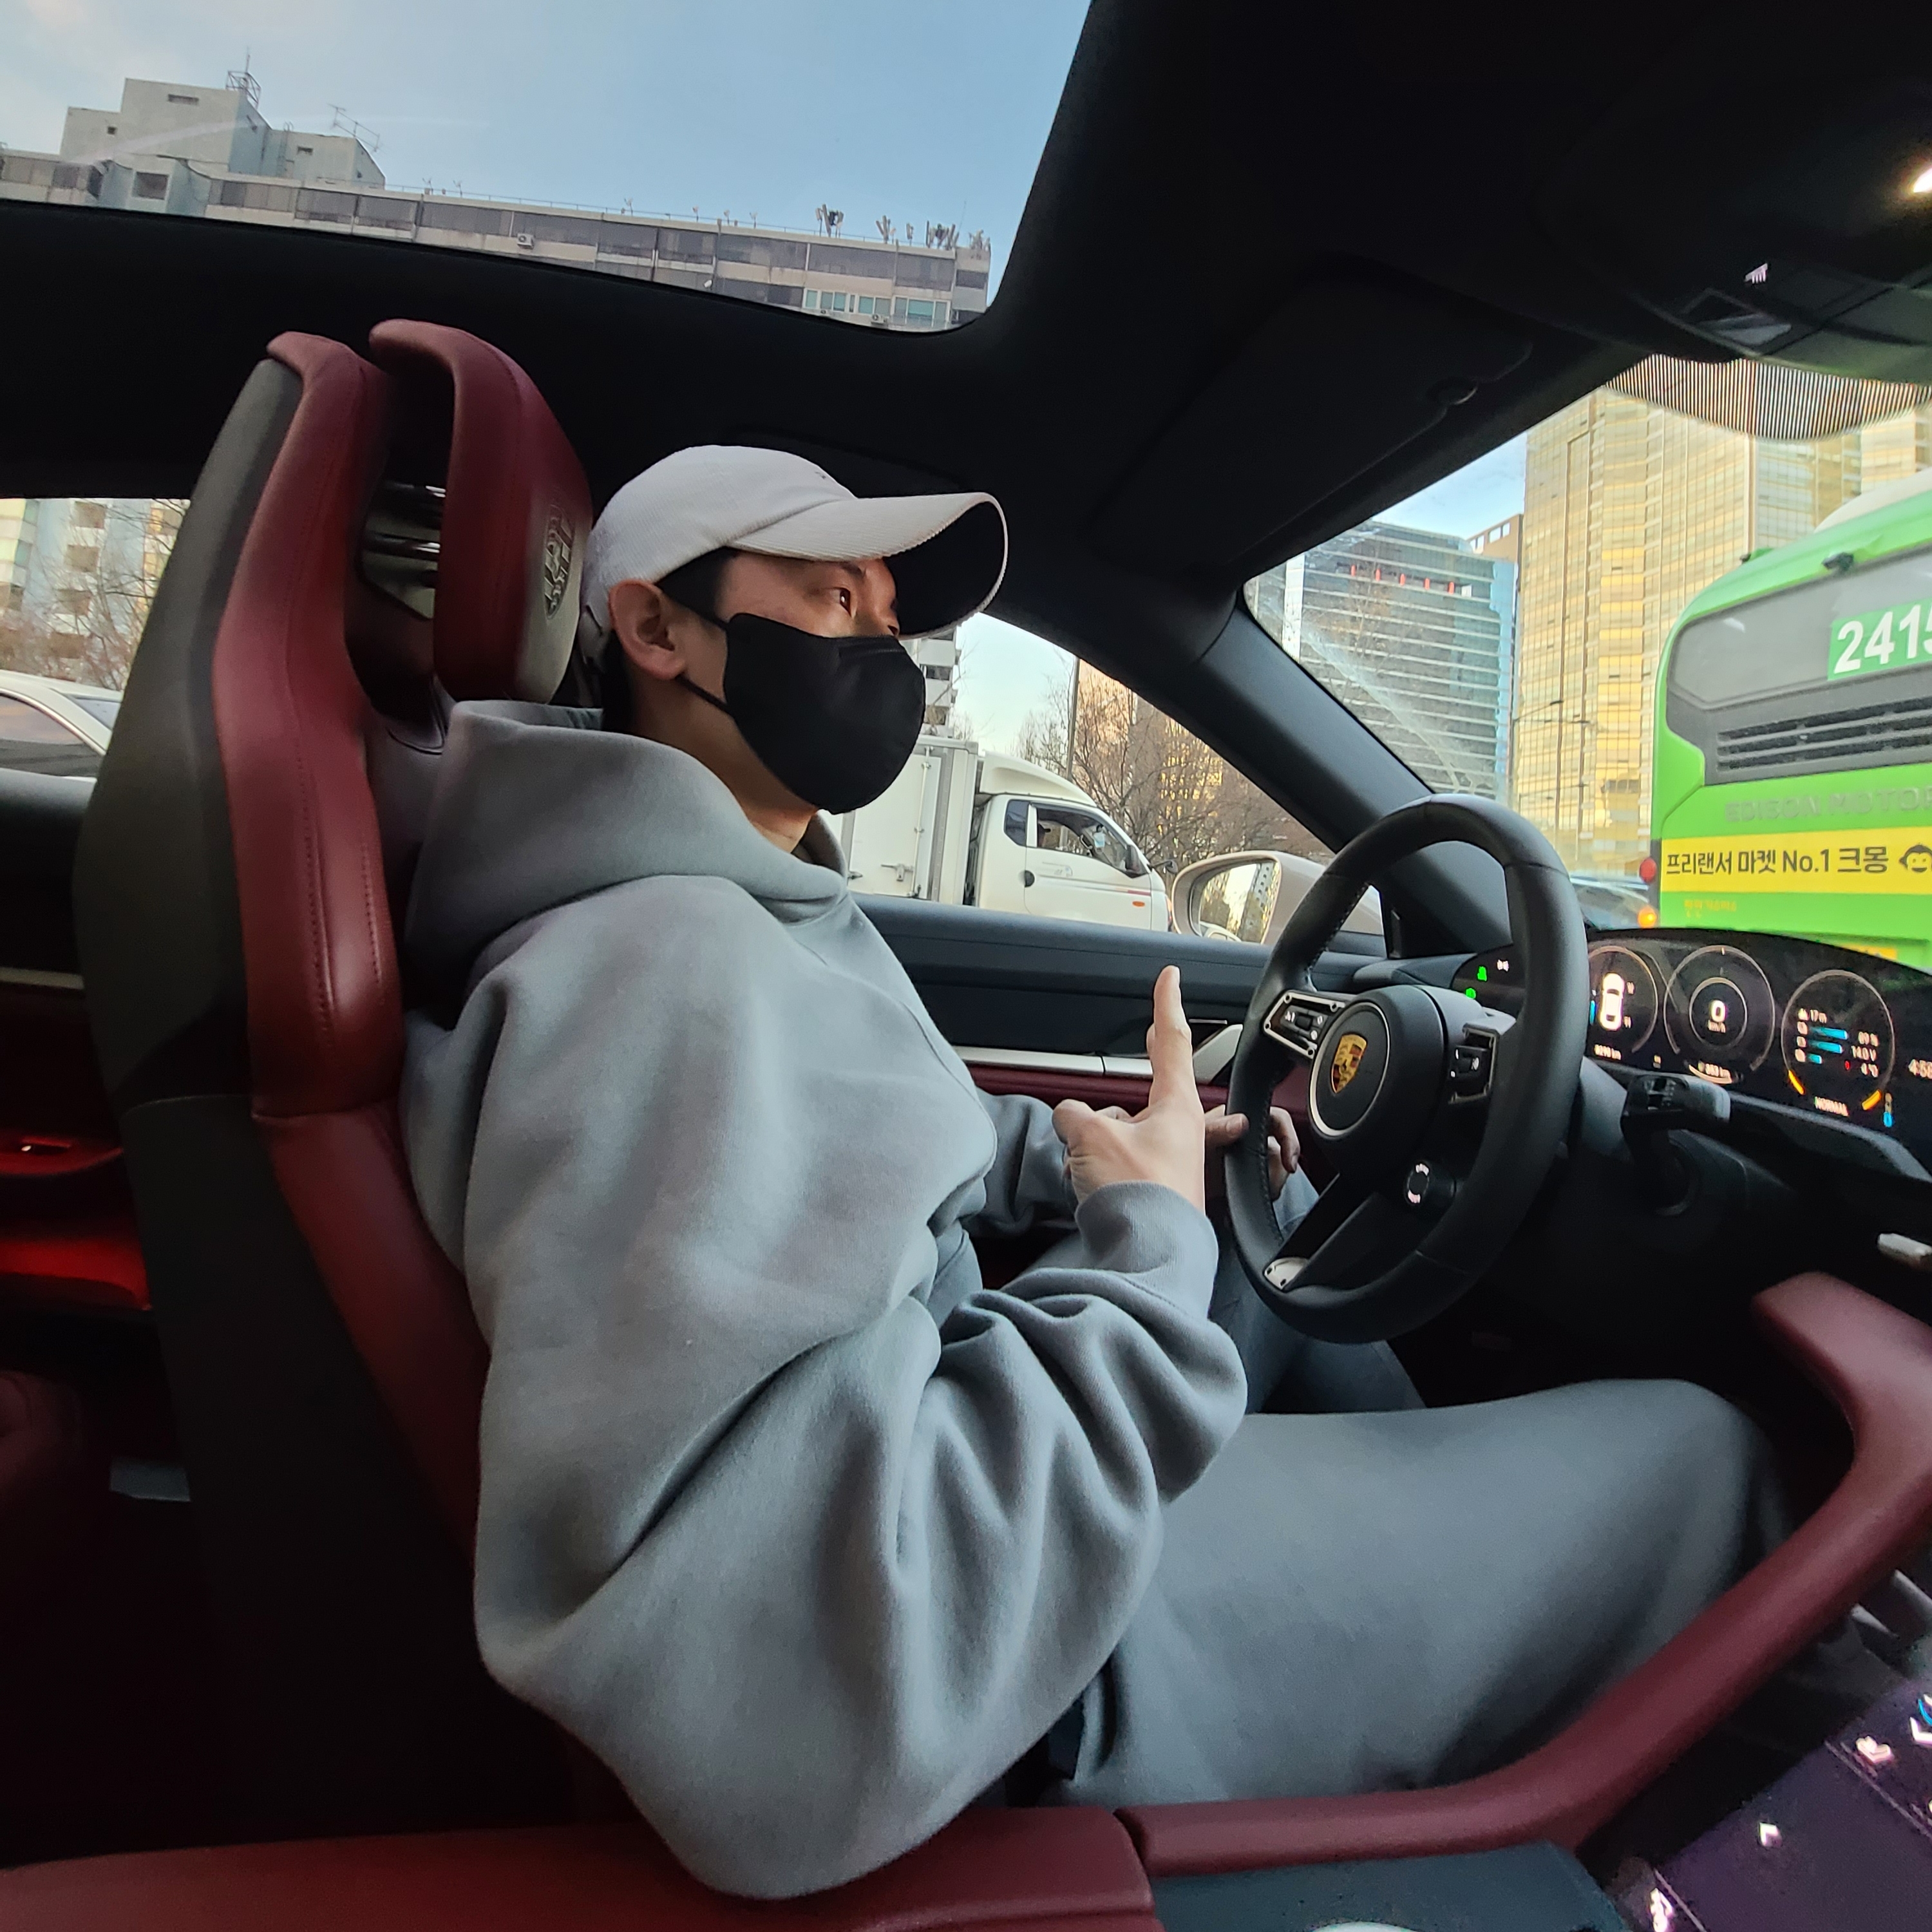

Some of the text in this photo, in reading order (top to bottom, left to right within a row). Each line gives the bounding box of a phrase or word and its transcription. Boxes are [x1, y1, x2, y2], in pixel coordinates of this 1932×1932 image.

[1725, 795, 1821, 823] EDISON
[1666, 846, 1889, 875] 프리랜서 마켓 No.1 크몽
[1710, 999, 1727, 1023] 0
